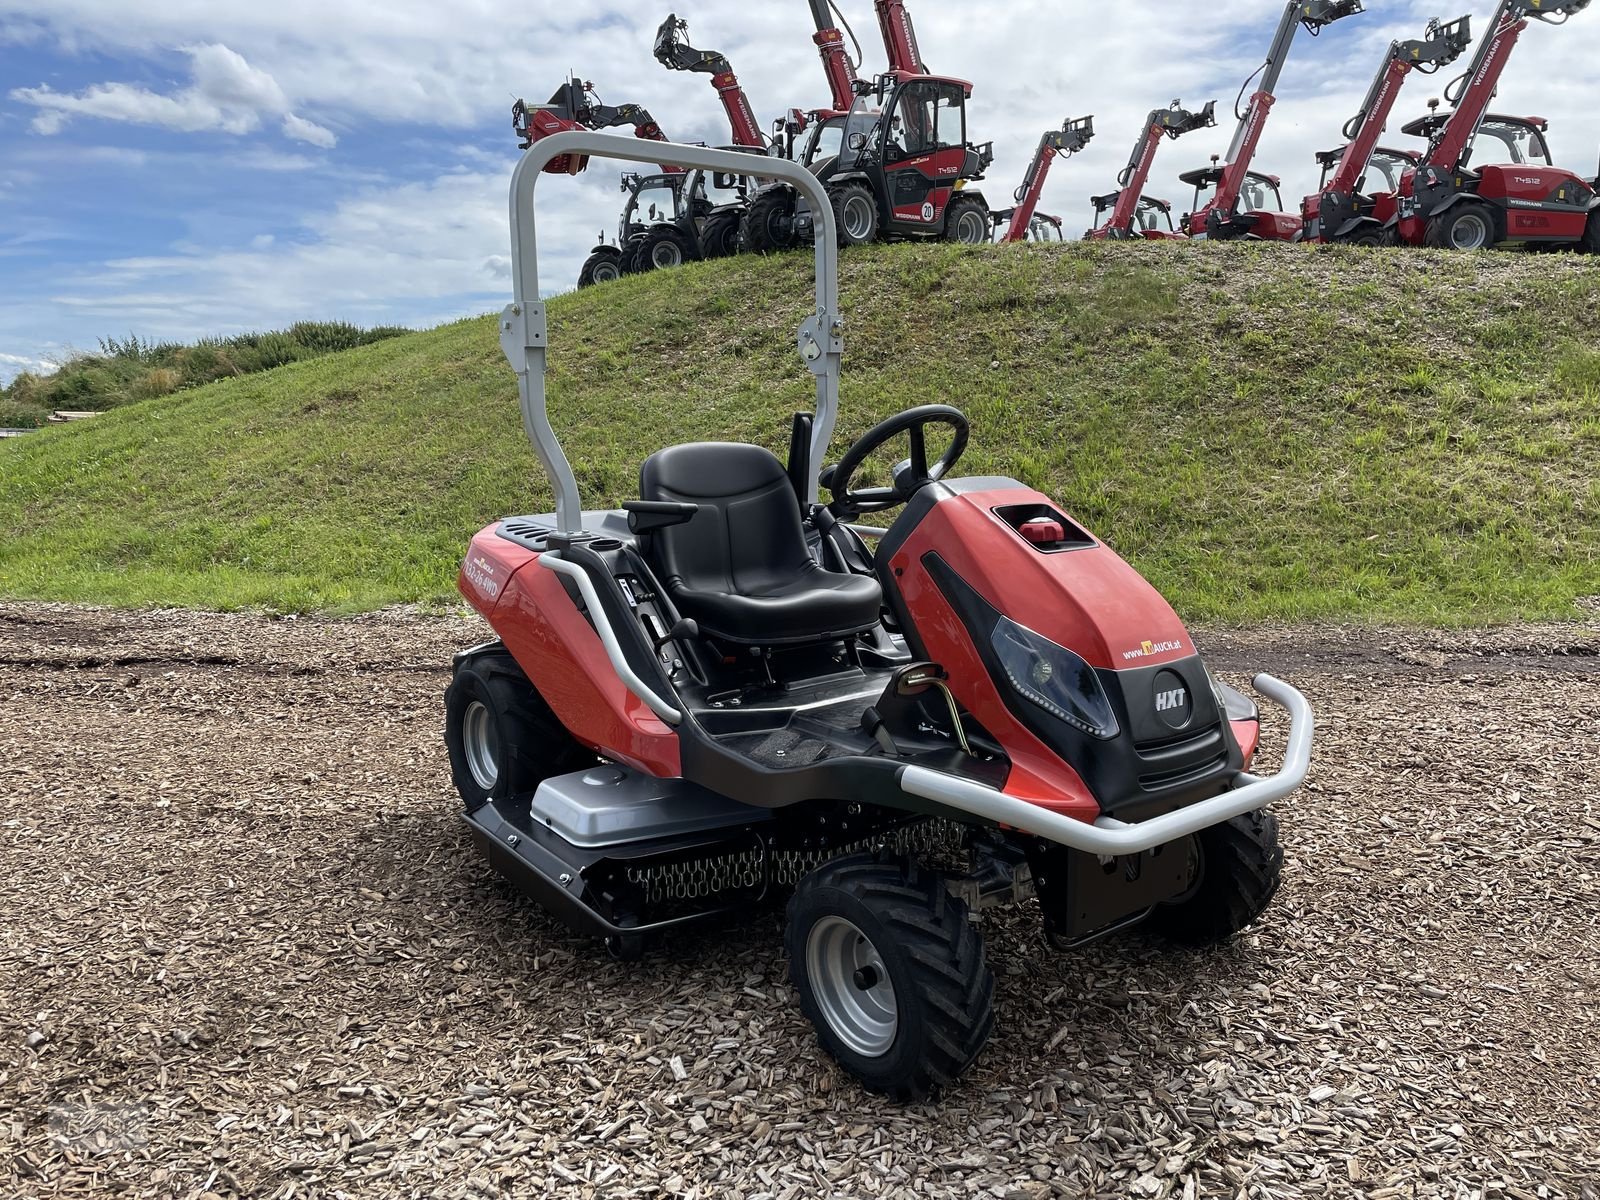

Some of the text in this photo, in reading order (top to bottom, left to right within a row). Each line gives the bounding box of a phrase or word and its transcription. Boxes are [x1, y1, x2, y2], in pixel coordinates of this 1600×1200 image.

[900, 10, 917, 66] WEIDEMANN
[1474, 38, 1501, 86] WEIDEMANN
[1368, 80, 1391, 121] WEIDEMANN
[737, 96, 758, 139] WEIDEMANN
[924, 206, 931, 218] 20
[1510, 199, 1542, 207] WEIDEMANN
[482, 576, 498, 597] 4WD
[1155, 688, 1186, 712] HXT
